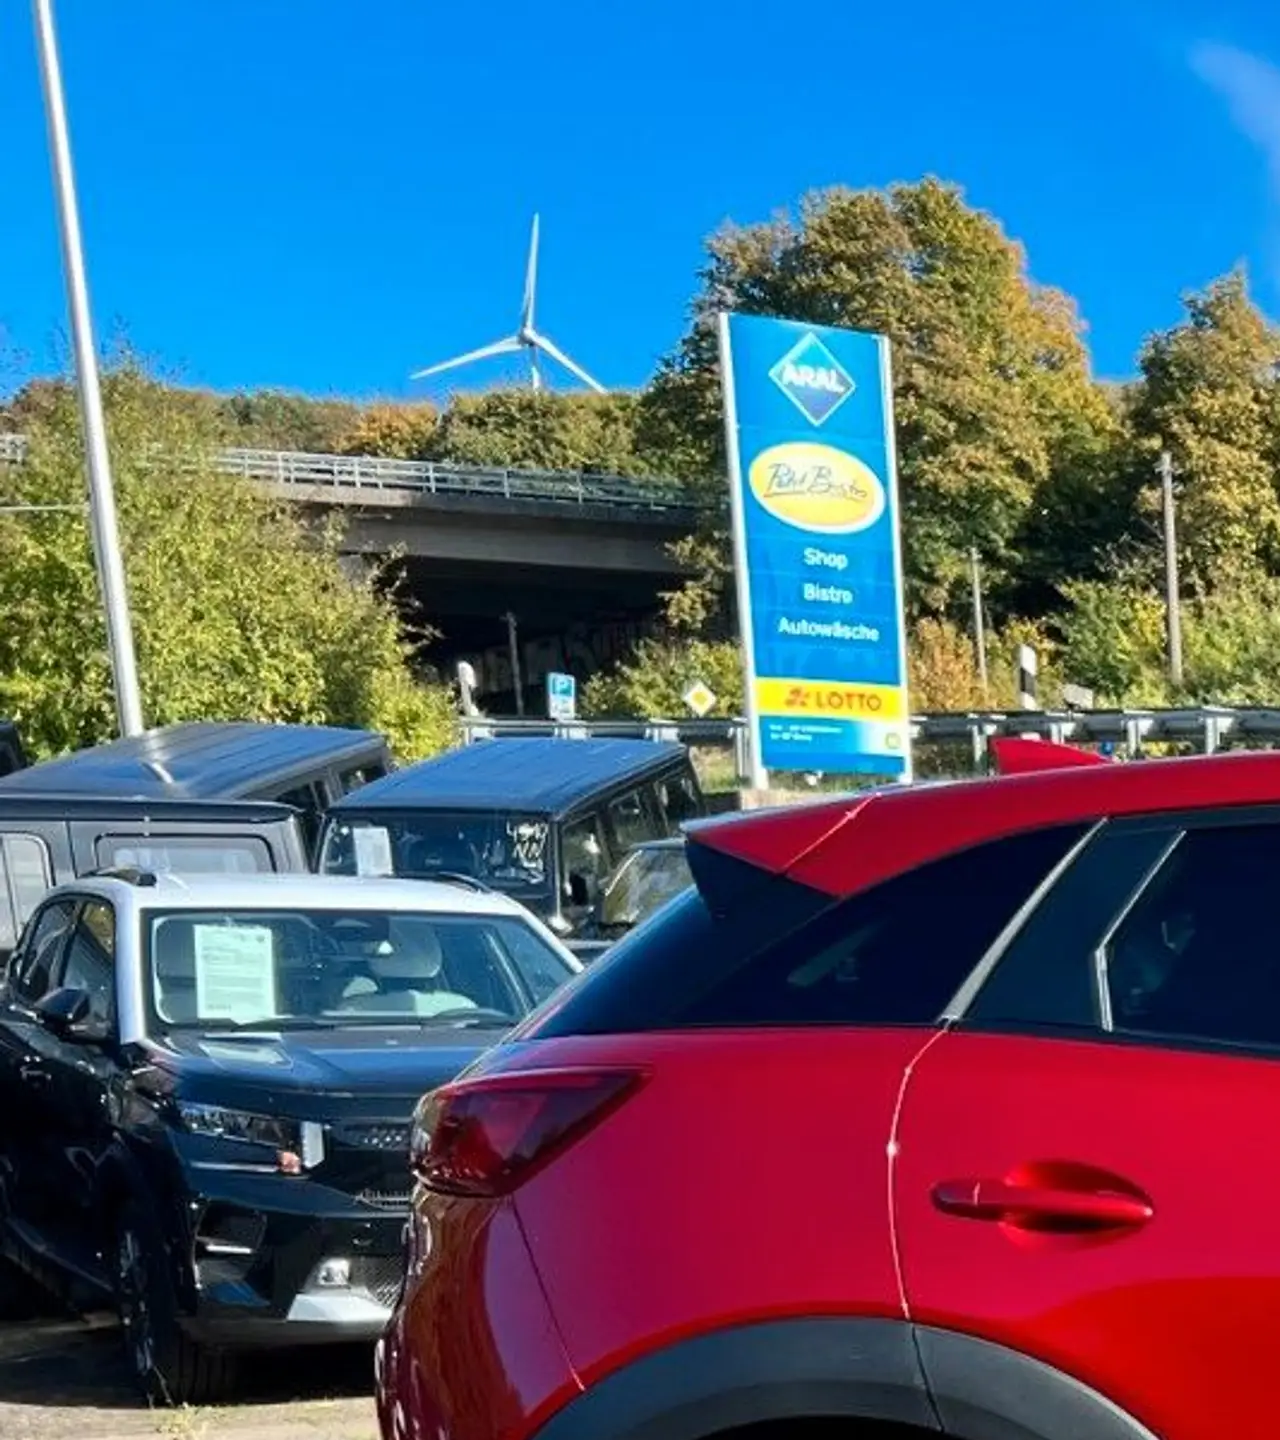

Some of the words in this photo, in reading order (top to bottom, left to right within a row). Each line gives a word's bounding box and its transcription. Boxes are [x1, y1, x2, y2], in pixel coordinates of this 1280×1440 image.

[781, 362, 845, 393] ARAL
[804, 548, 848, 571] Shop
[803, 582, 853, 604] Bistro
[778, 616, 880, 642] Autowäsche
[815, 690, 882, 712] LOTTO
